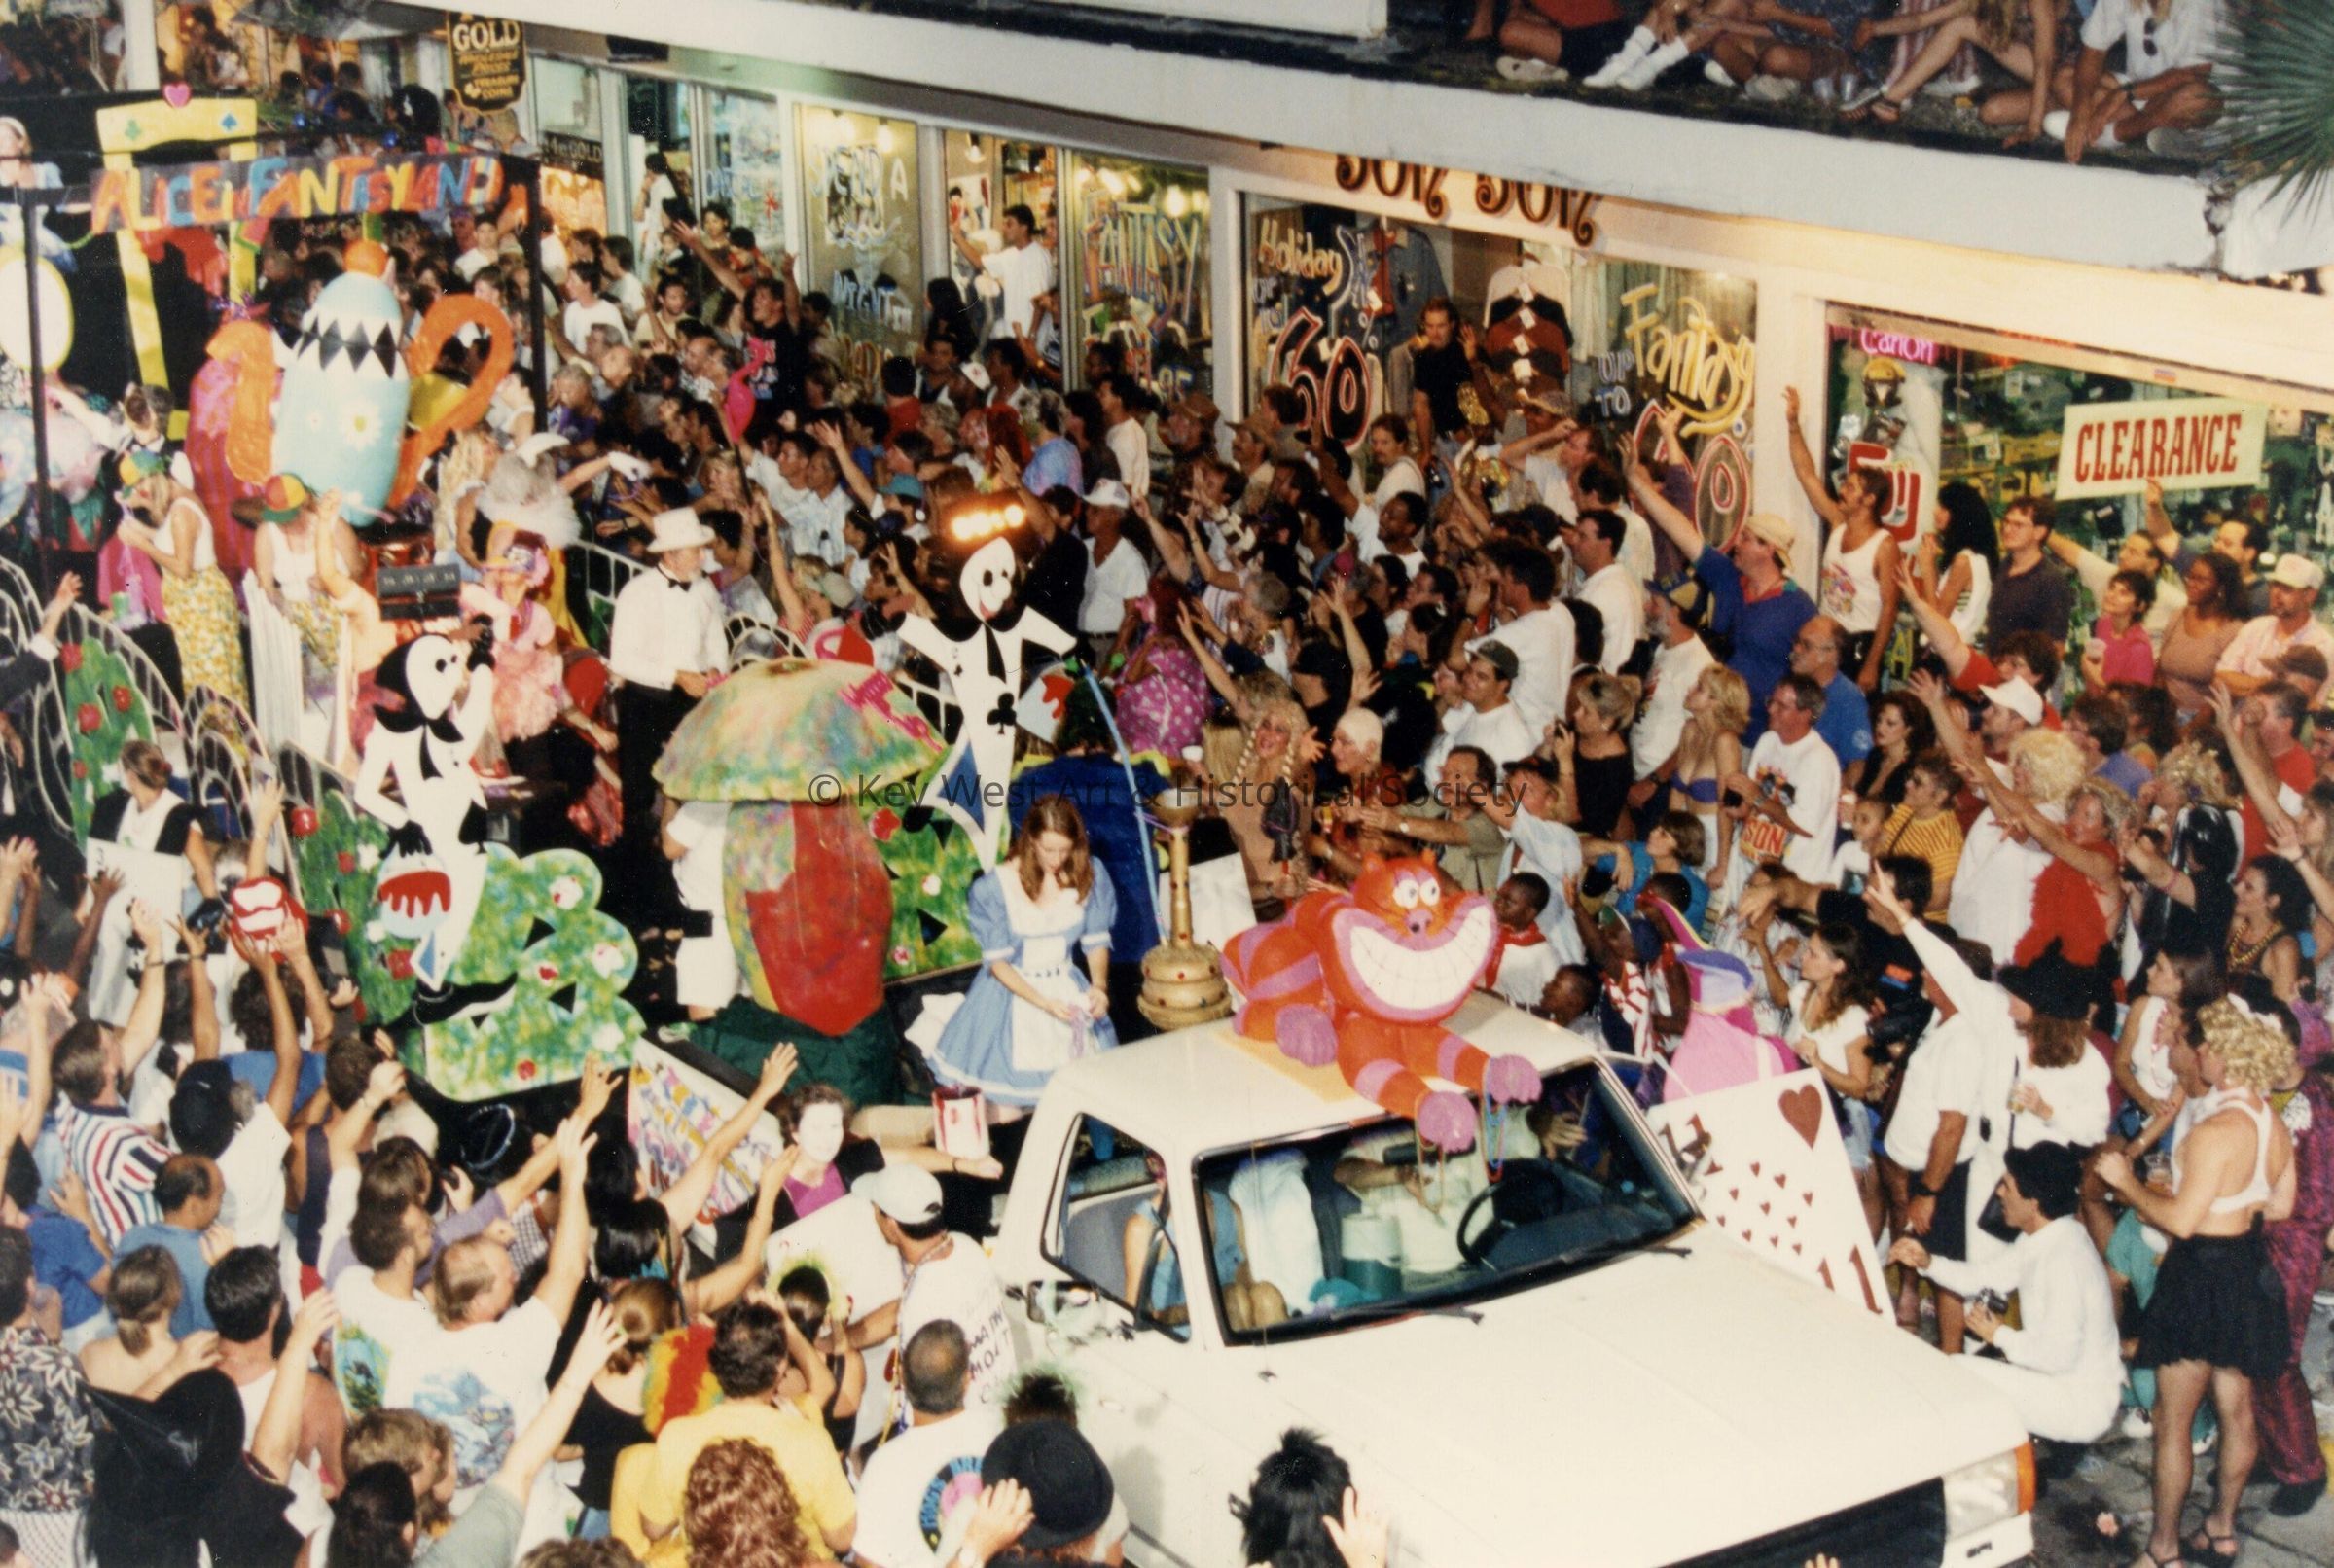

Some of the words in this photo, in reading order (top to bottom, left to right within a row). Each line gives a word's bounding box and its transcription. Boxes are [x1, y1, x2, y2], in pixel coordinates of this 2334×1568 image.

[452, 20, 521, 51] GOLD
[91, 165, 223, 236] ALICE
[246, 156, 505, 219] FANTASYLAND
[889, 157, 909, 201] A
[1258, 217, 1343, 296] Holiday
[1598, 348, 1635, 383] UP
[1620, 282, 1757, 438] Fantasy
[1857, 325, 1936, 365] Canon
[1595, 385, 1632, 417] TO
[2074, 413, 2242, 483] CLEARANCE
